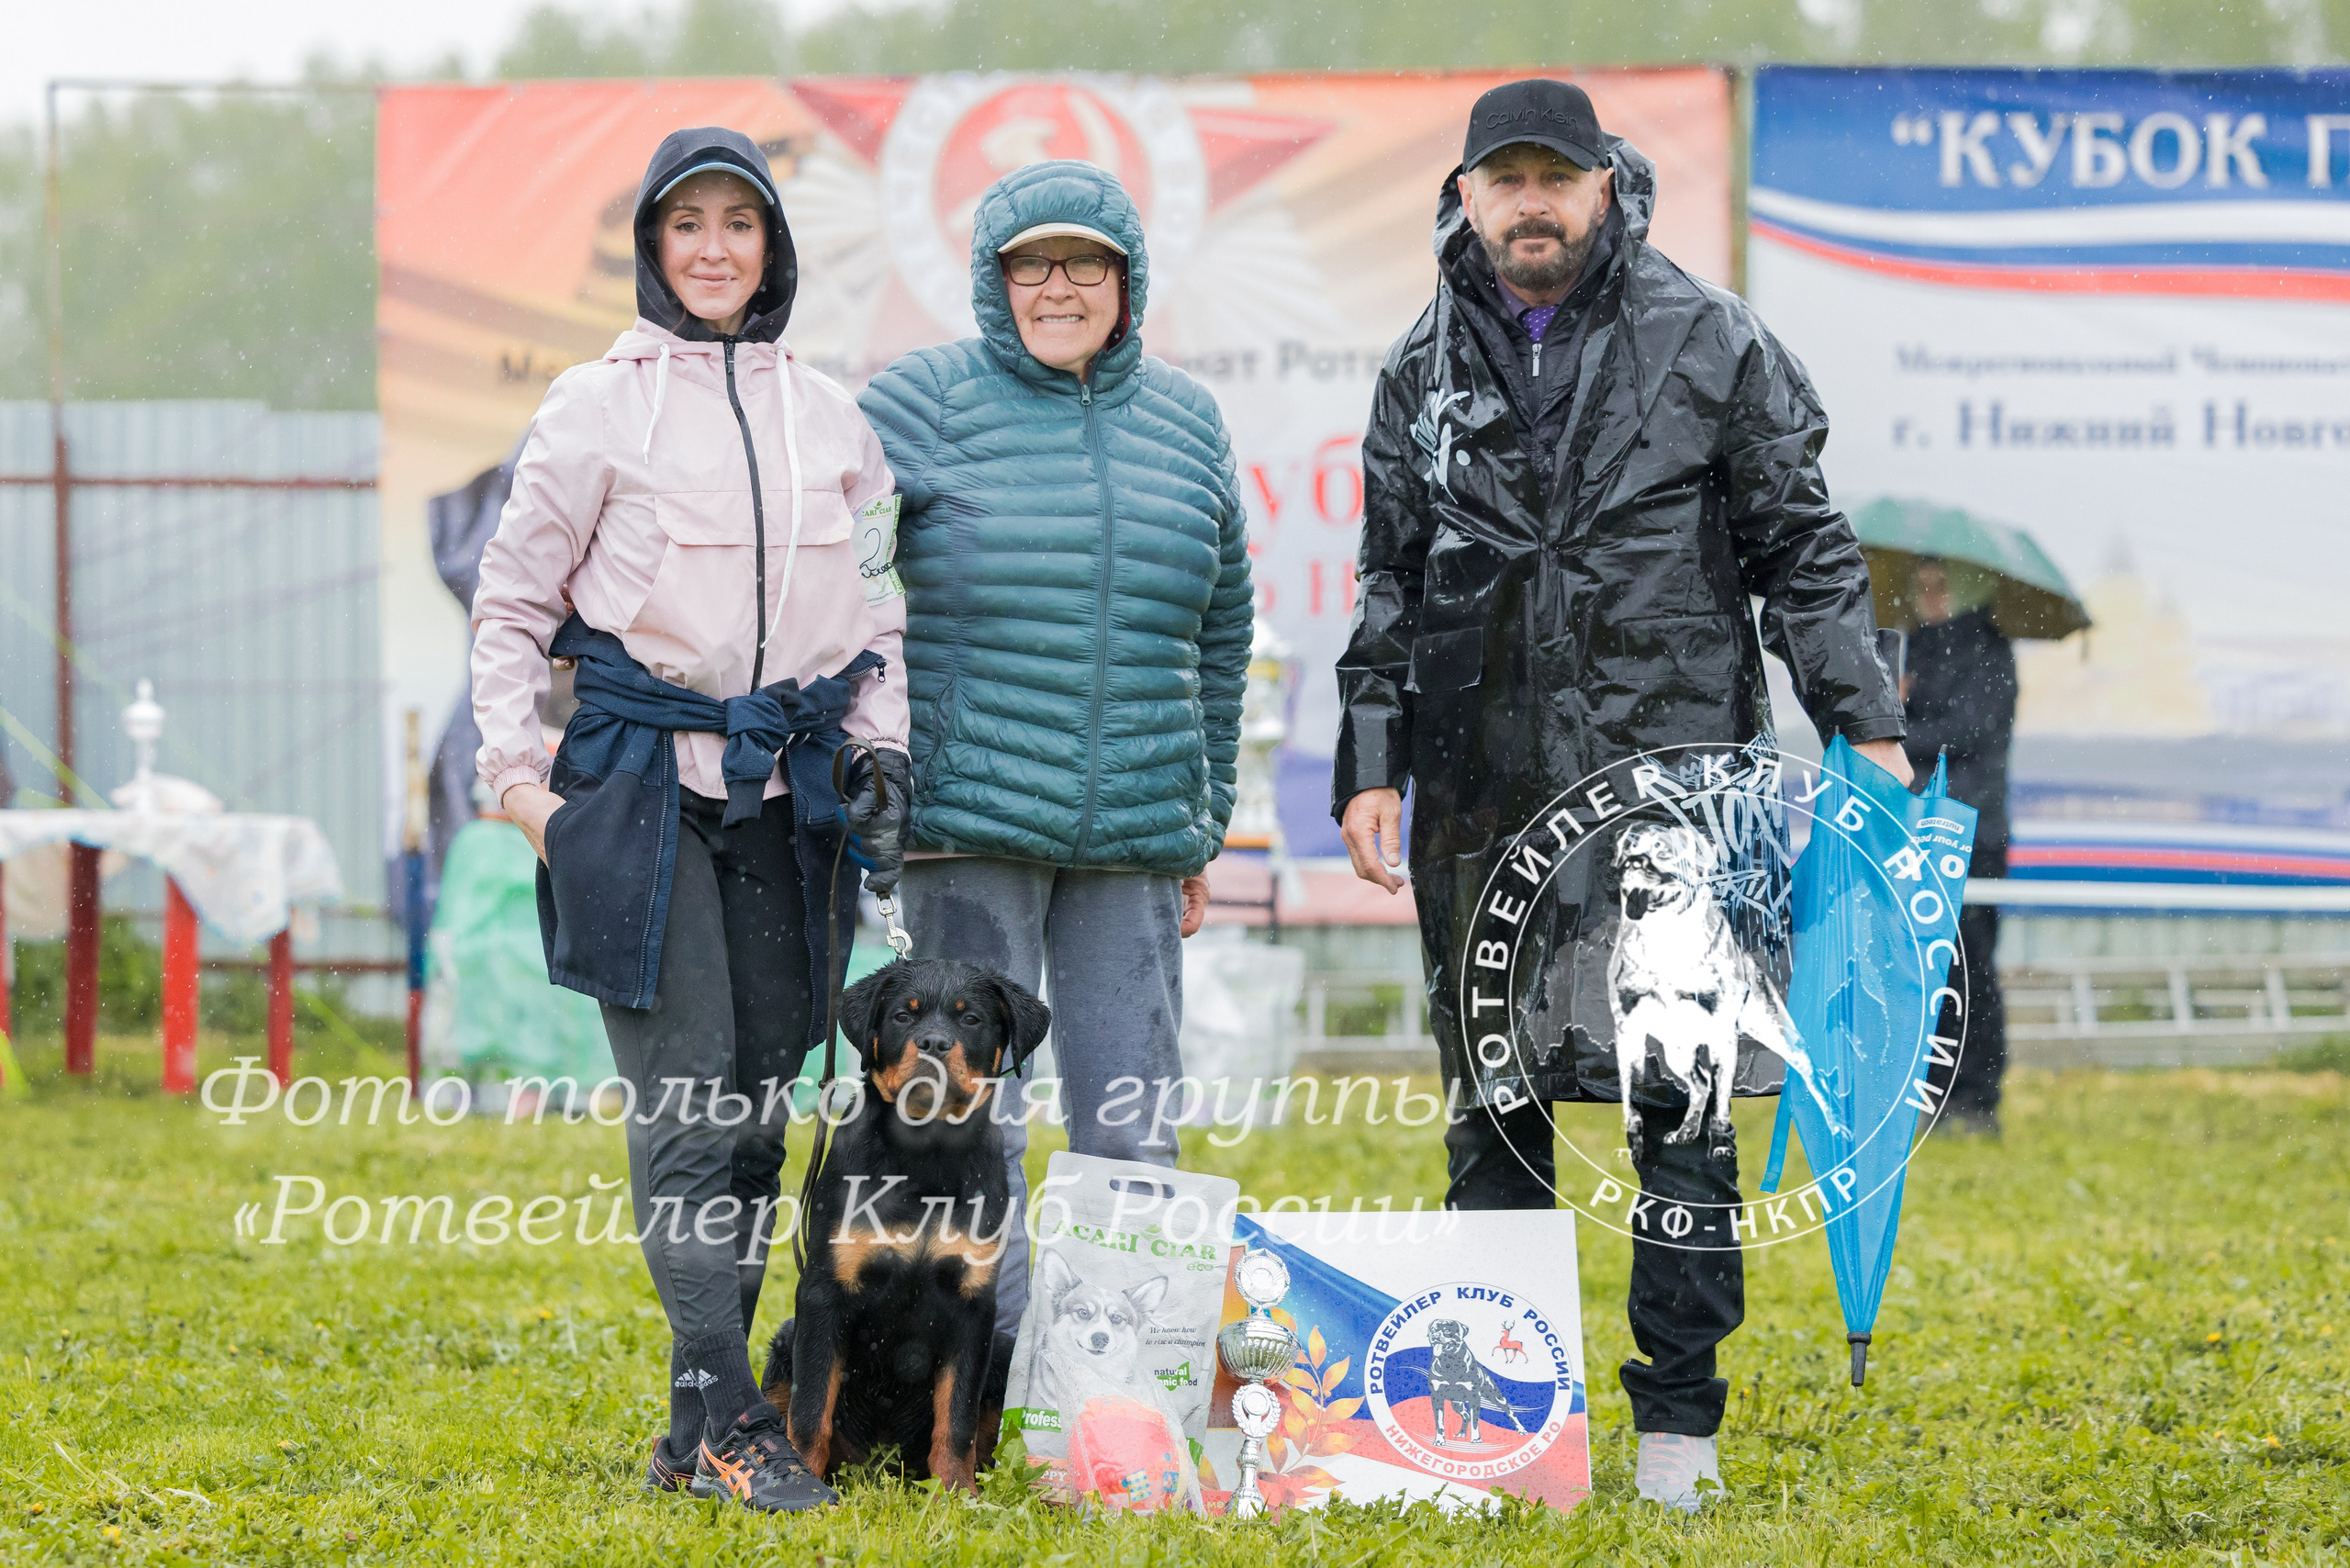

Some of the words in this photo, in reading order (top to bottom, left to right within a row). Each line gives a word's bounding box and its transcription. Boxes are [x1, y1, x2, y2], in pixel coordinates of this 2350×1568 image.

[1485, 107, 1537, 129] Calvin
[1540, 107, 1579, 129] Klein
[1920, 819, 1961, 832] nutratech
[1932, 834, 1959, 849] your
[1052, 1220, 1139, 1253] ACARI
[1186, 1262, 1214, 1271] eco
[1370, 1291, 1441, 1394] РОТВЕЙЛЕР
[1457, 1287, 1515, 1308] КЛУБ
[1523, 1309, 1571, 1391] РОССИИ
[1154, 1367, 1187, 1376] natural
[1180, 1377, 1198, 1386] food
[1385, 1424, 1542, 1478] НИЖЕГОРОДСКОЕ
[1541, 1421, 1561, 1444] РО
[1041, 1470, 1068, 1482] PPY
